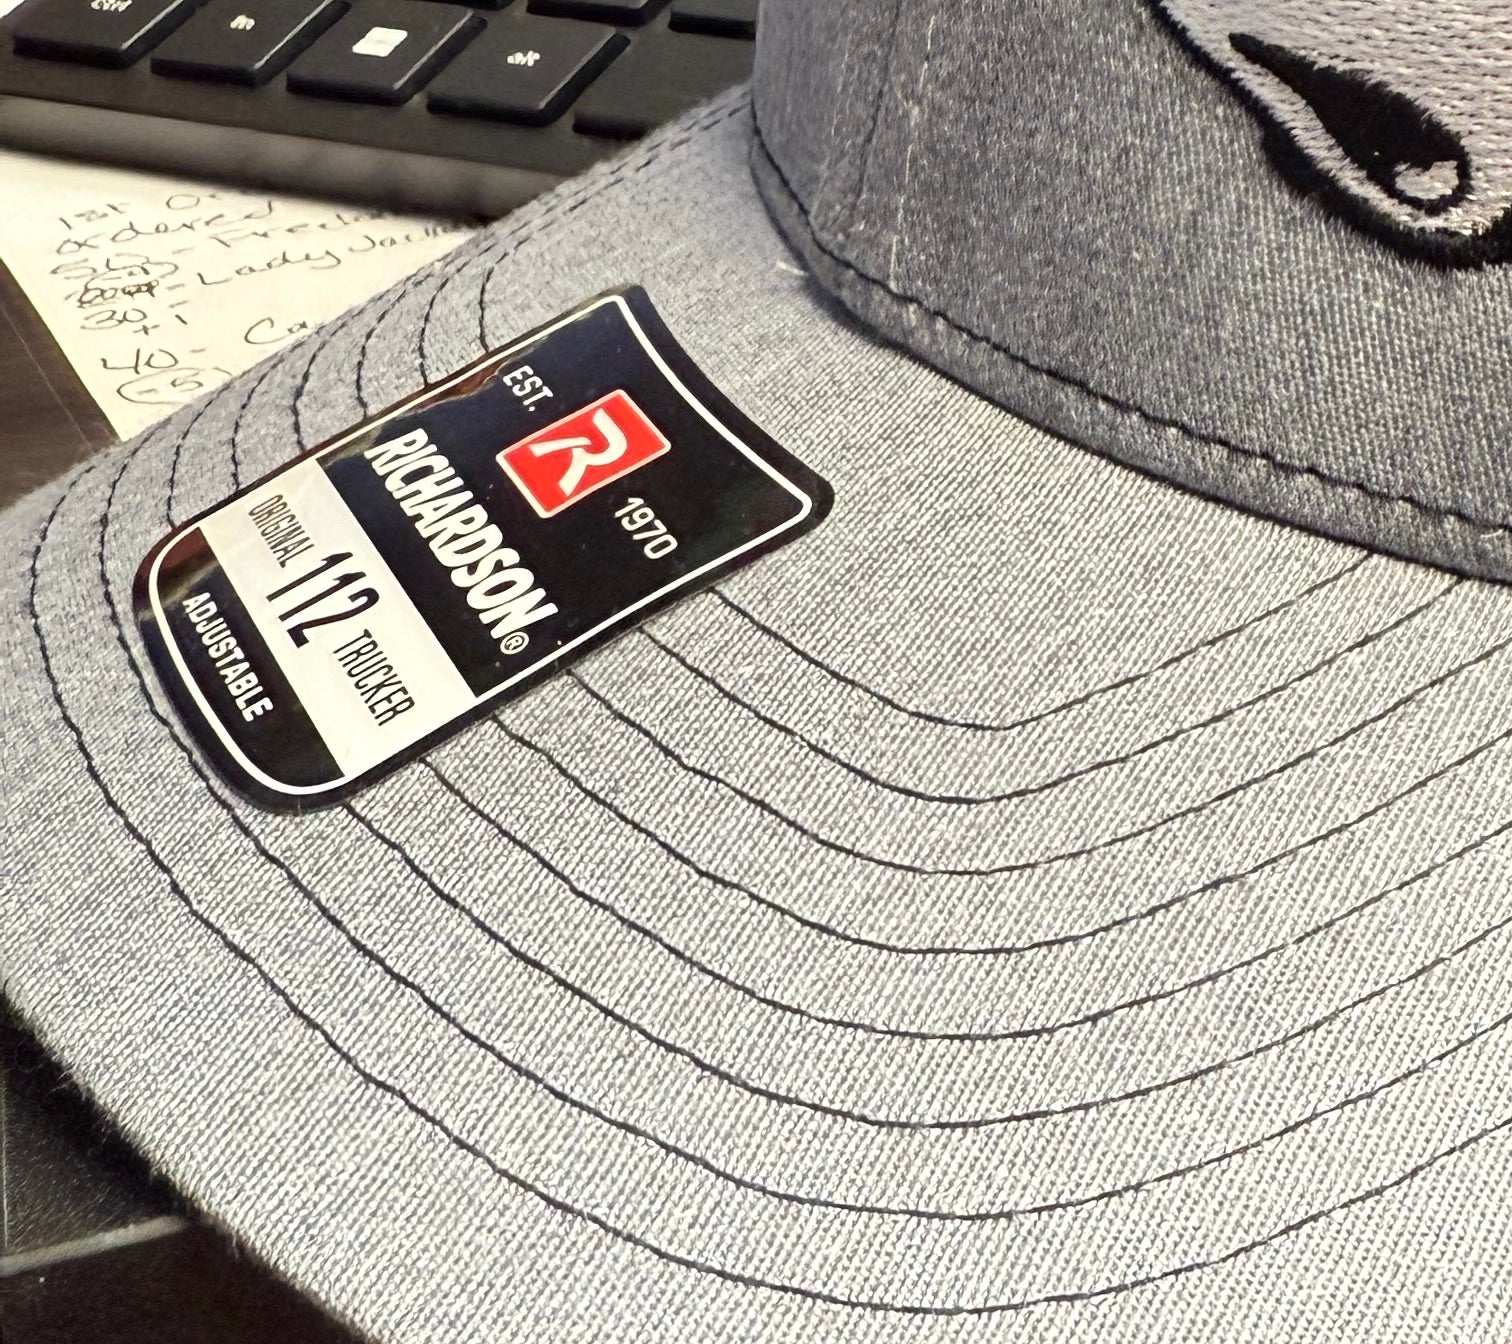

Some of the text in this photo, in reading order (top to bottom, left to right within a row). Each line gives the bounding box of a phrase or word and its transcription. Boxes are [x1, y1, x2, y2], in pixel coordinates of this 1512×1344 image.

[503, 364, 554, 412] EST.
[614, 497, 678, 560] 1970
[182, 591, 274, 723] ADJUSTABLE
[248, 493, 416, 727] ORIGINAL 112 TRUCKER
